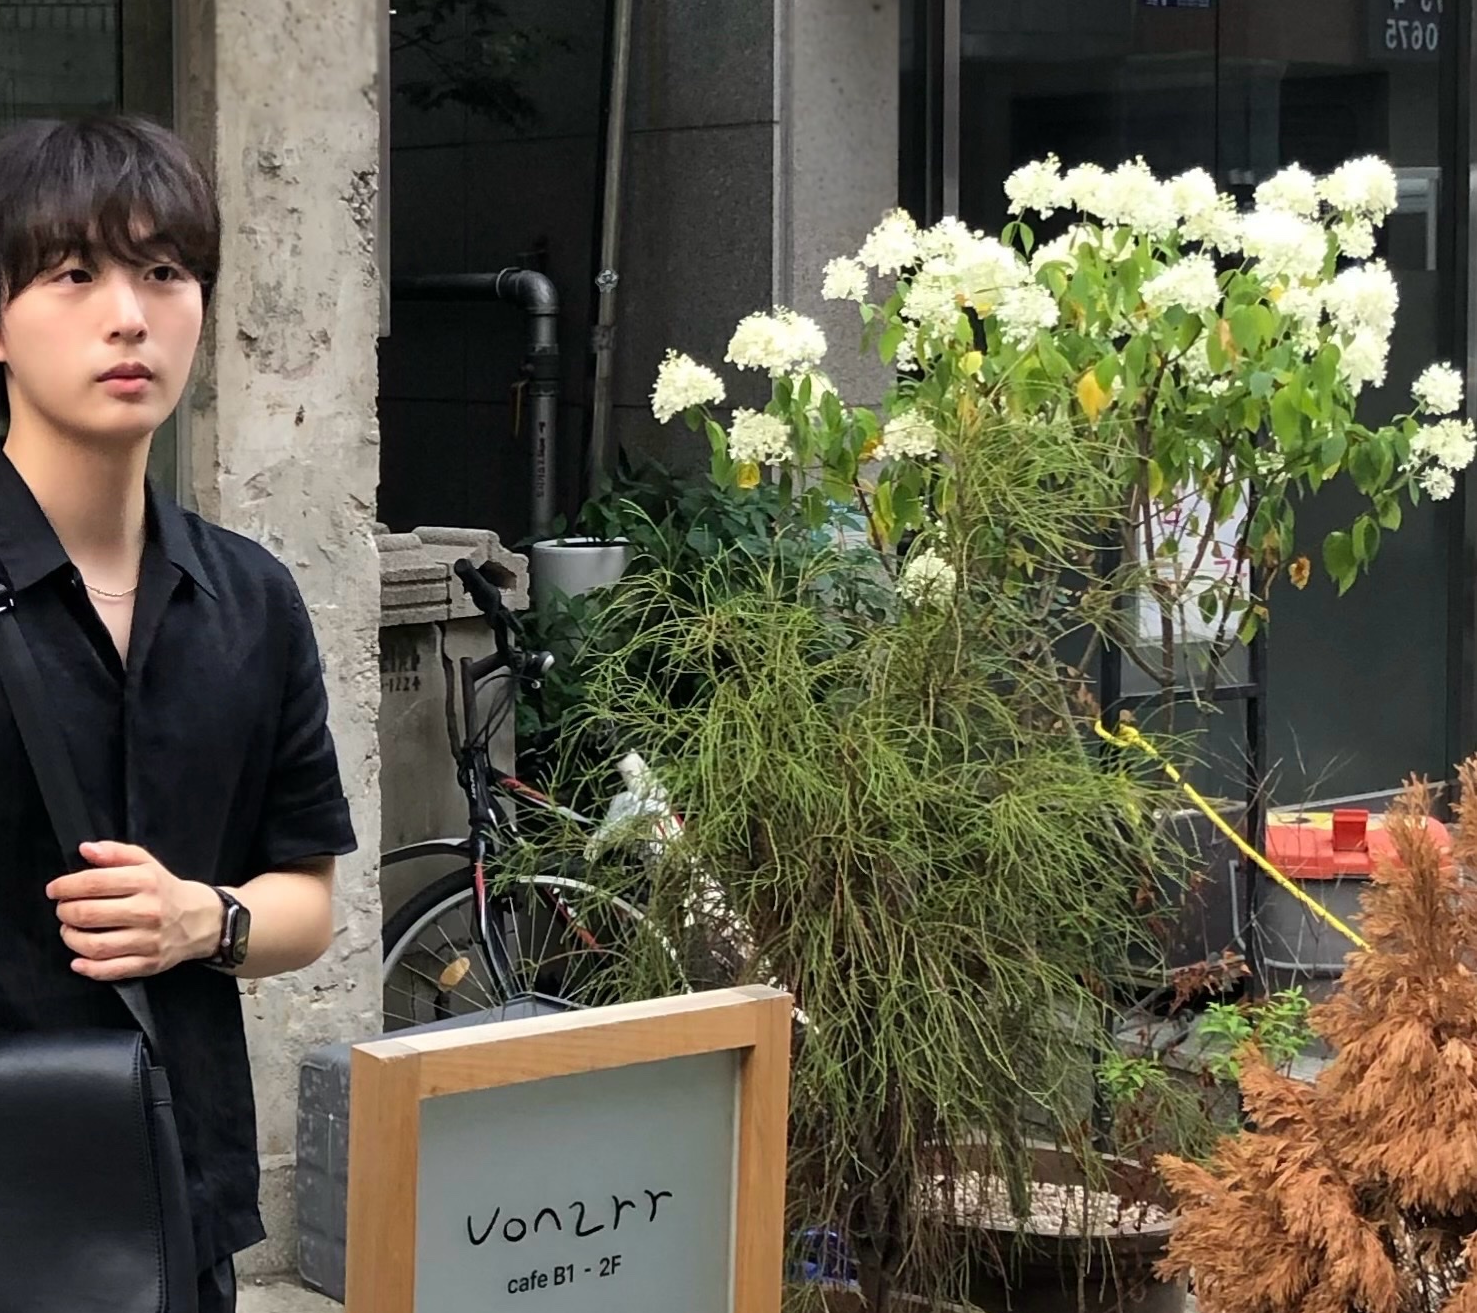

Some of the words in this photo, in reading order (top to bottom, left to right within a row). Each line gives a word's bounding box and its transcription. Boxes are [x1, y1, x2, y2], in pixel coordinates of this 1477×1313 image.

[467, 1189, 673, 1245] vonzrr
[507, 1269, 549, 1295] cafe
[553, 1264, 576, 1286] B1
[599, 1254, 623, 1279] 2F
